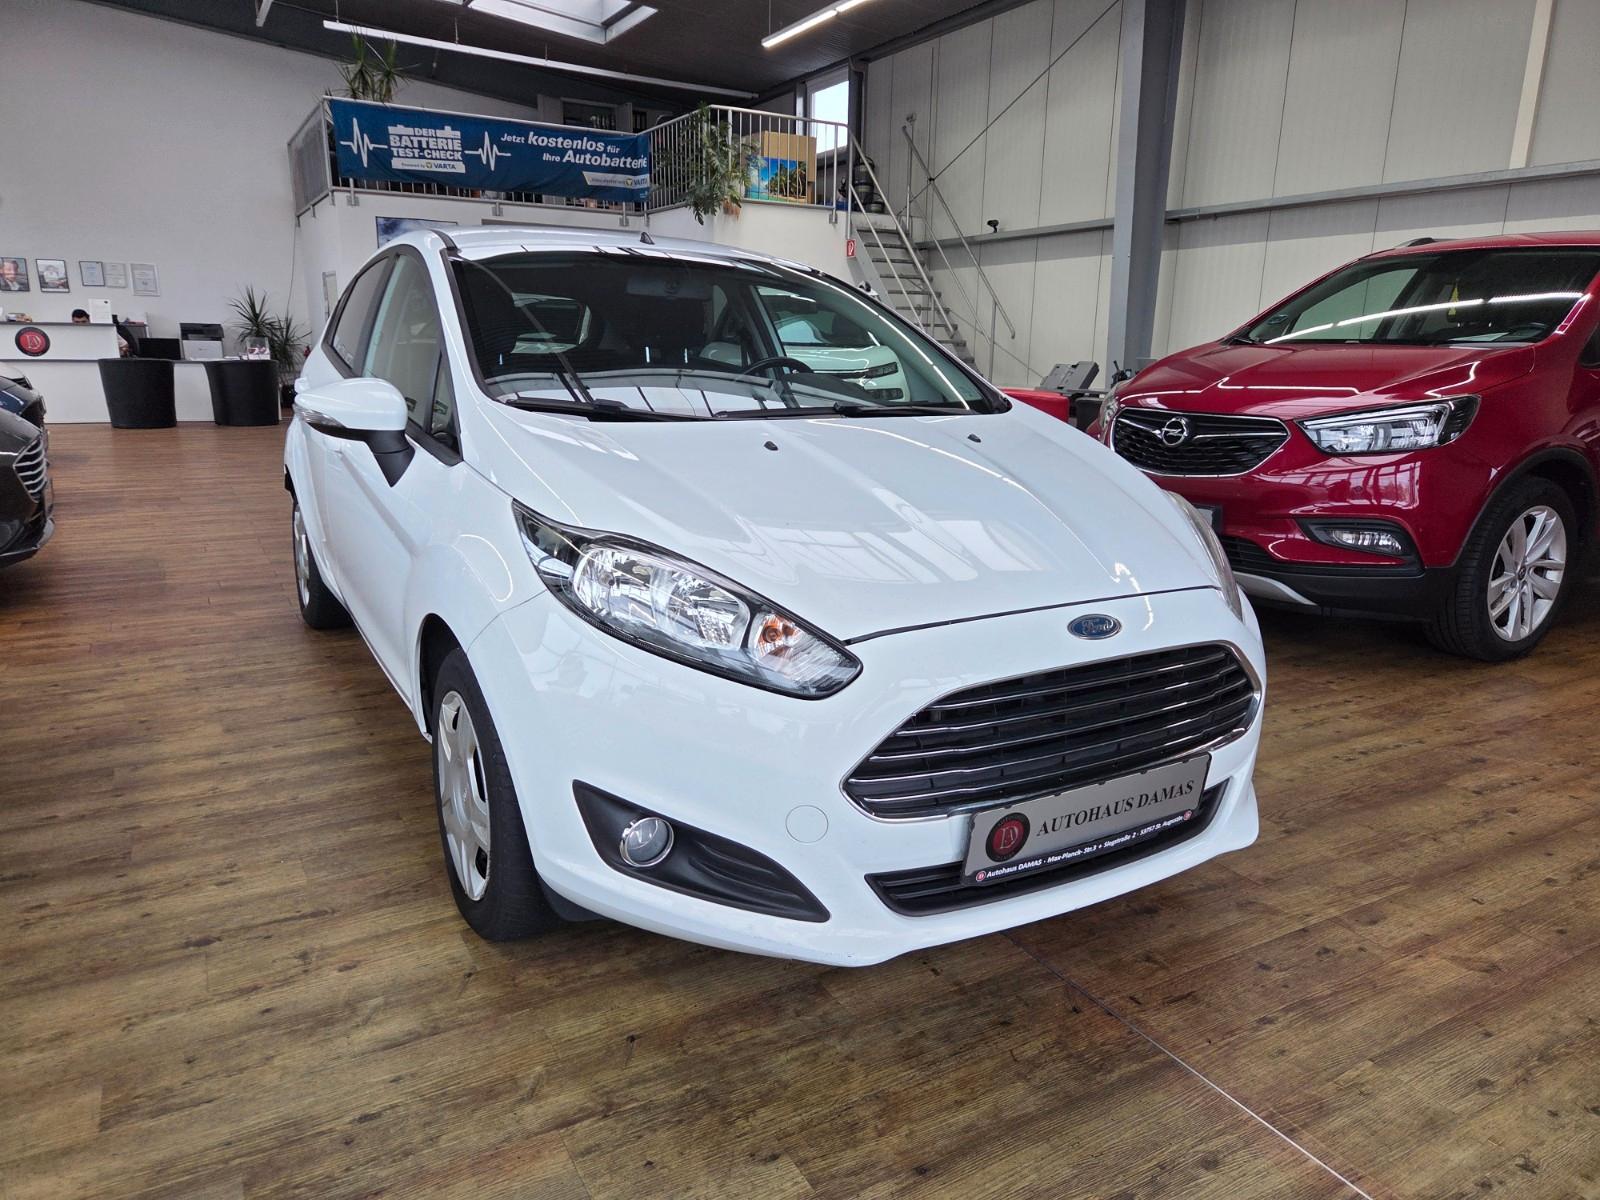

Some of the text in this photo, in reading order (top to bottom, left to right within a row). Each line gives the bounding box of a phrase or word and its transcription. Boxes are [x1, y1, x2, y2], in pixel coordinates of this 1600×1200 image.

[414, 127, 436, 137] DER
[389, 134, 462, 151] BATTERIE
[501, 131, 620, 154] Jetzt kostenlos für
[391, 147, 463, 161] TEST-CHECK
[542, 152, 561, 162] Ihre
[433, 162, 457, 170] VARTA
[1036, 797, 1134, 836] AUTOHAUS
[1137, 780, 1195, 809] DAMAS
[986, 865, 1017, 878] Autohaus
[1018, 858, 1042, 870] DAMAS
